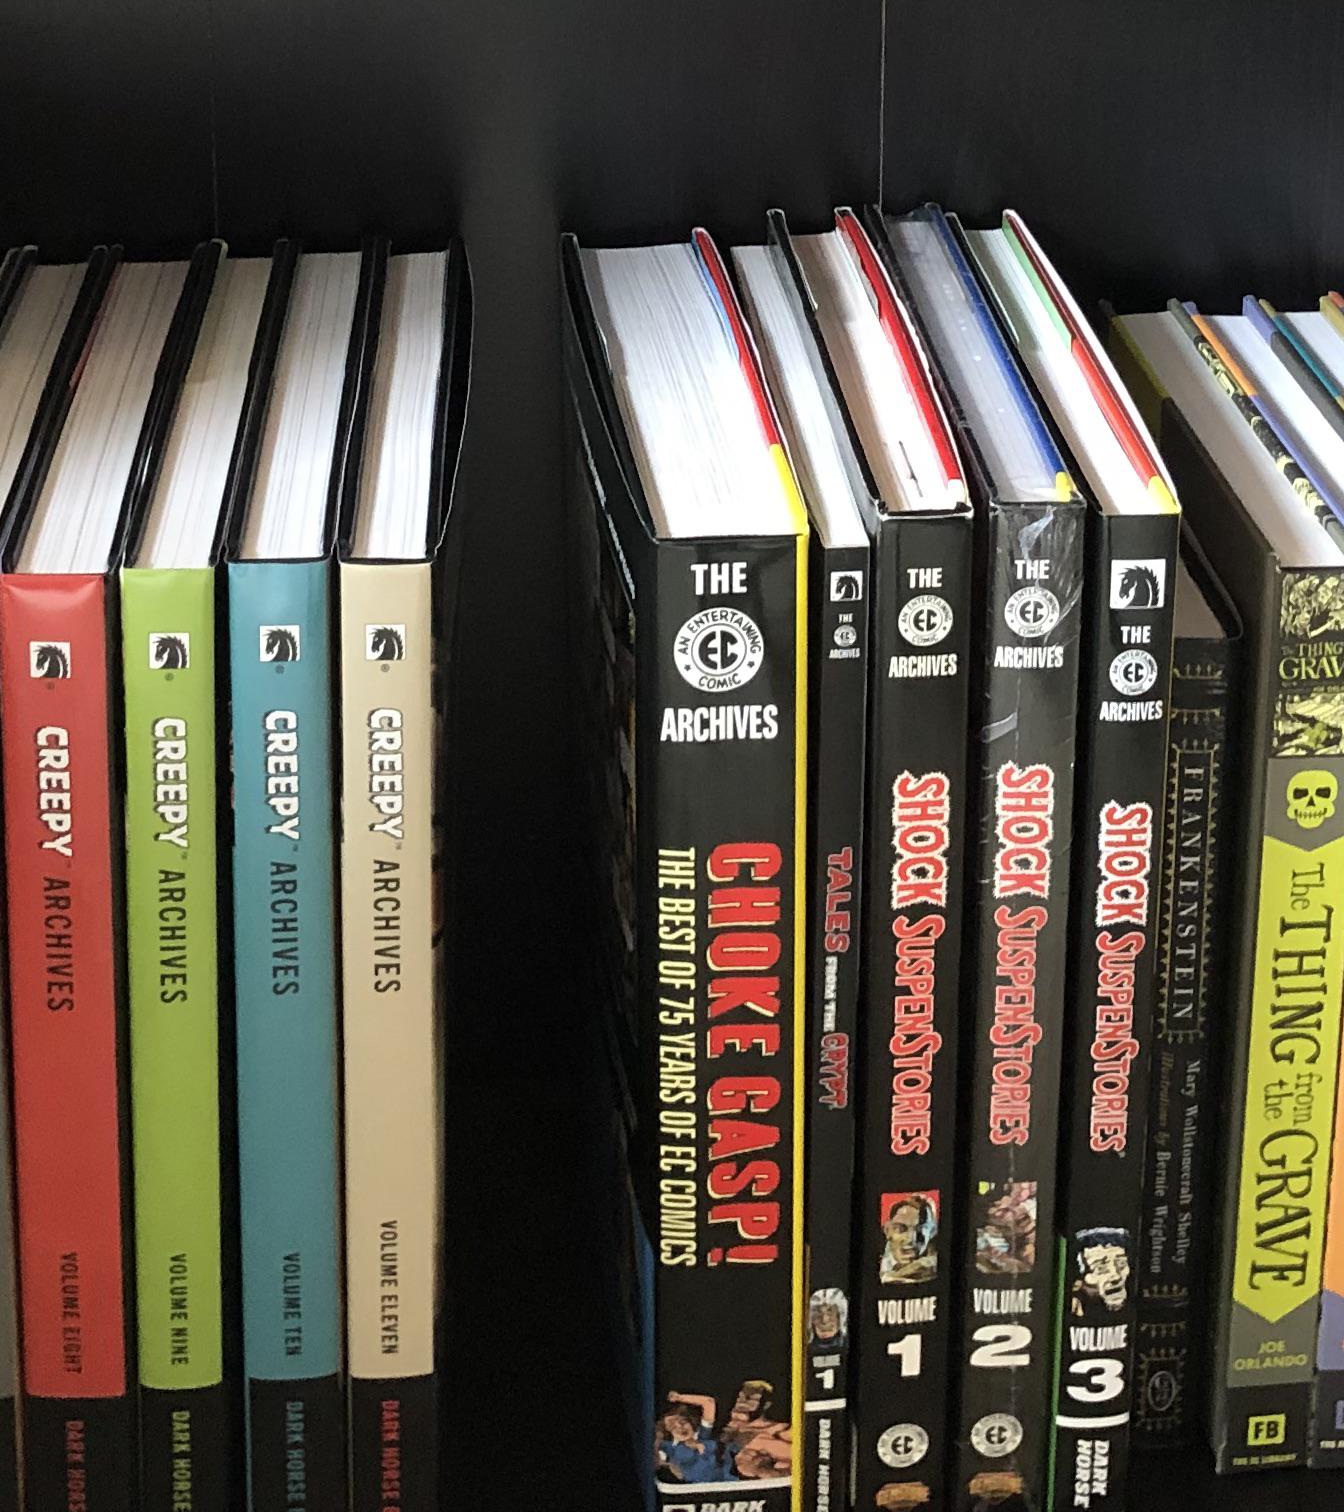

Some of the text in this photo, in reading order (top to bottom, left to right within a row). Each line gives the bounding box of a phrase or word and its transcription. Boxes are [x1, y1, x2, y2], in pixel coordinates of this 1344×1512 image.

[691, 562, 747, 595] THE
[698, 629, 739, 670] EC
[888, 653, 958, 678] ARCHIVES
[698, 673, 742, 689] COMIC
[661, 704, 778, 742] ARCHIVES
[890, 770, 950, 909] SHOCK
[1174, 766, 1204, 1022] FRANKENSTEIN
[658, 847, 698, 1267] THE BEST OF 75 YEARS OF EC COMICS
[706, 842, 782, 1267] CHOKE GASP!
[1181, 1059, 1200, 1097] Mary
[1247, 862, 1333, 1292] The THING from the GRAVE
[1172, 1212, 1192, 1264] Shelley
[283, 1252, 302, 1357] VOLUME TEN
[380, 1219, 399, 1356] VOLUME ELEVEN
[973, 1288, 1032, 1314] VOLUME
[60, 1252, 81, 1375] VOLUME EIGHT
[169, 1252, 188, 1367] VOLUME NINE
[878, 1296, 936, 1324] VOLUME
[886, 1334, 922, 1377] 1
[970, 1324, 1032, 1367] 2
[1234, 1355, 1307, 1371] ORLANDO
[1258, 1341, 1285, 1355] JOE
[1066, 1359, 1124, 1402] 3
[1074, 1440, 1109, 1509] DARK HORSE
